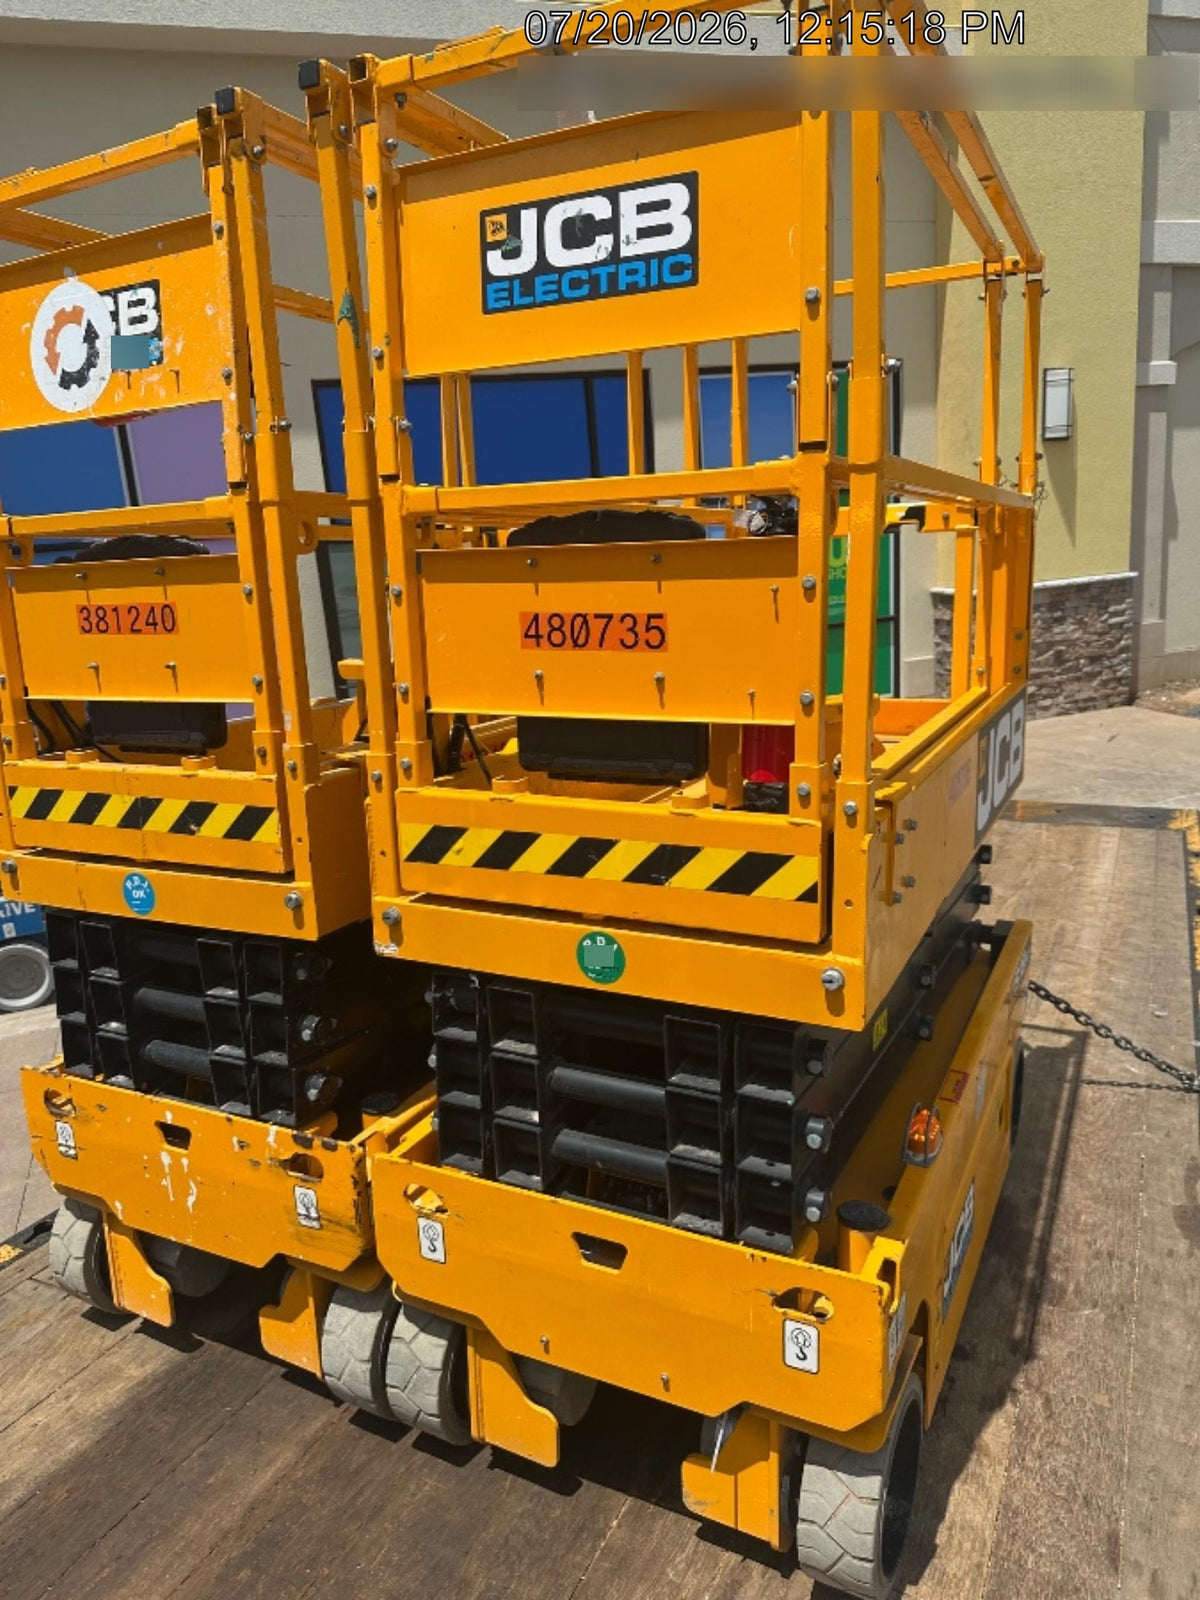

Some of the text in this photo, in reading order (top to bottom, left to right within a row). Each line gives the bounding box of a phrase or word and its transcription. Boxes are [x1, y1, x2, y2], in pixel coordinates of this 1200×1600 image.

[486, 182, 693, 277] JCB
[486, 253, 693, 311] ELECTRIC
[79, 604, 176, 634] 381240
[523, 612, 666, 650] 480735
[977, 698, 1025, 832] JCB
